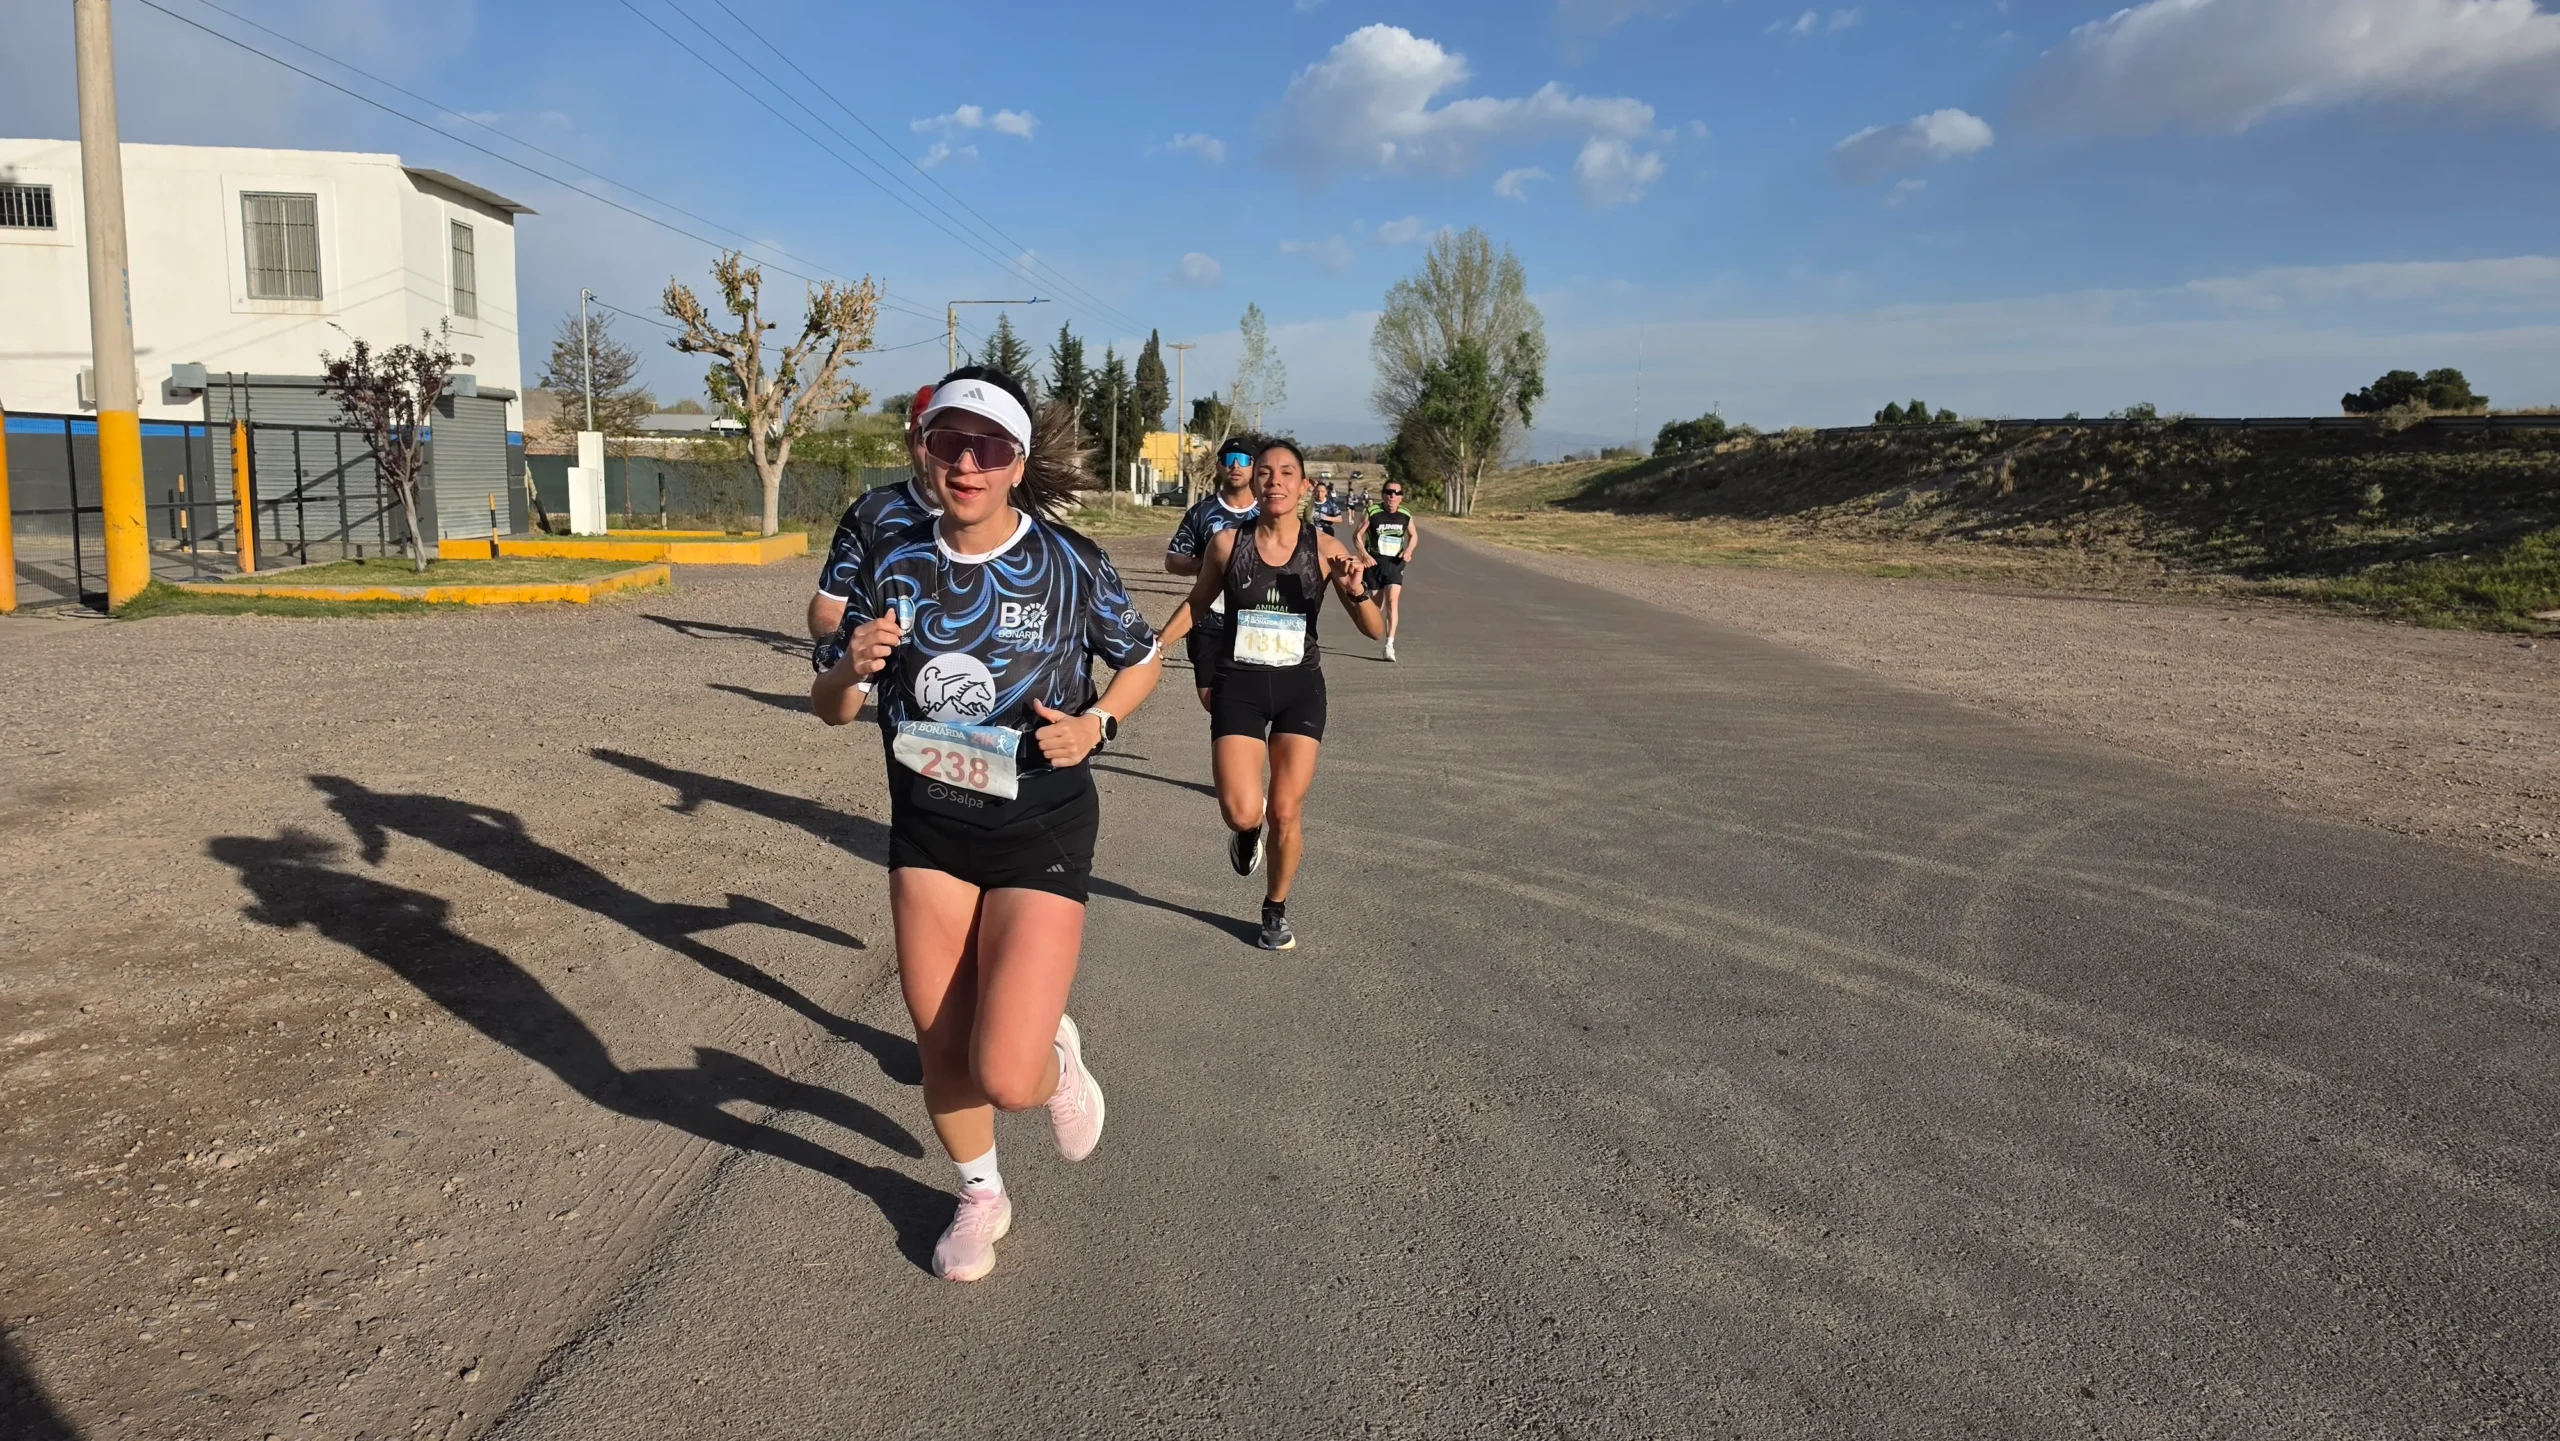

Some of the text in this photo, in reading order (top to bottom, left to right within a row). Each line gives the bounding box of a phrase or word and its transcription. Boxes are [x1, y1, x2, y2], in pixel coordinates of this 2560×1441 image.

[918, 721, 967, 740] BONARDA
[921, 746, 989, 789] 238
[949, 790, 984, 809] Salpa
